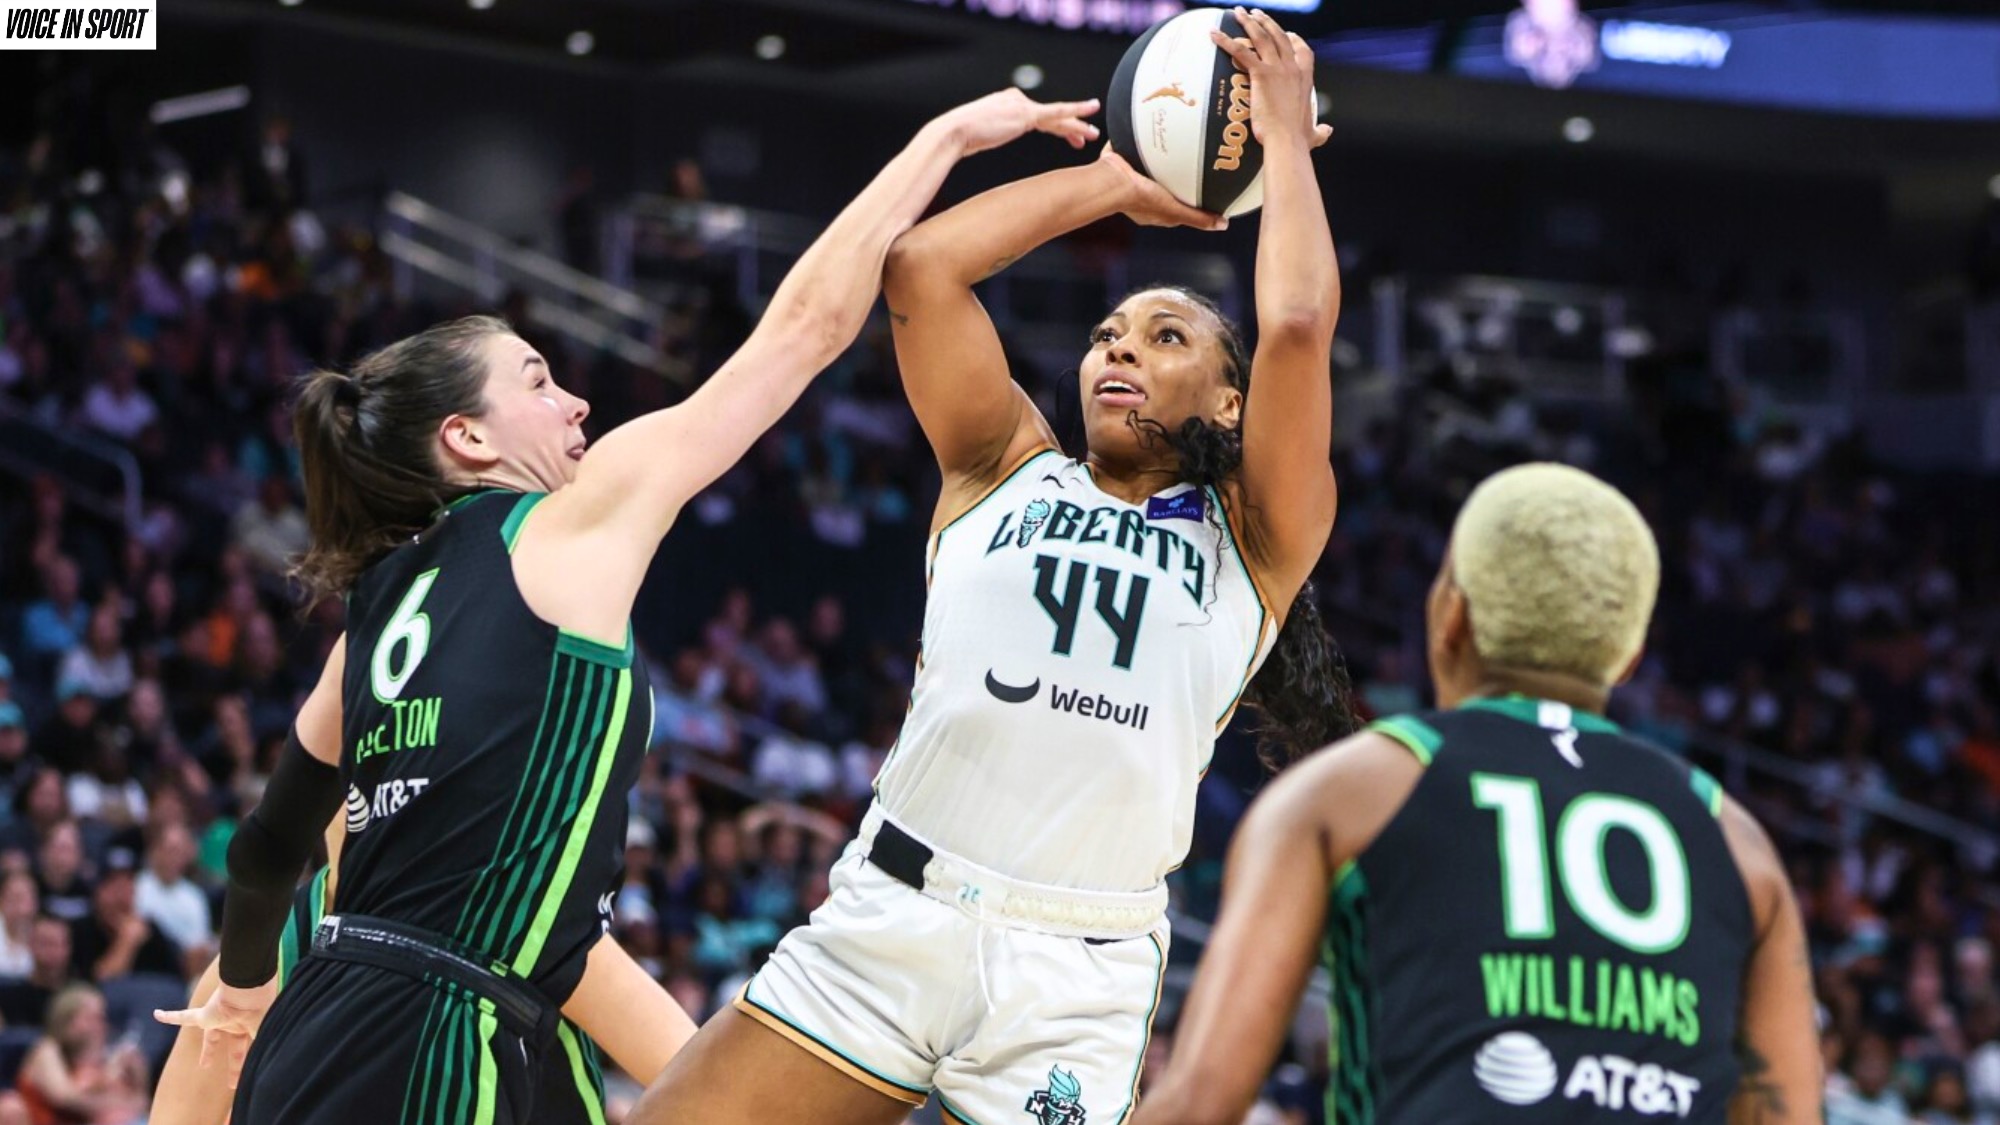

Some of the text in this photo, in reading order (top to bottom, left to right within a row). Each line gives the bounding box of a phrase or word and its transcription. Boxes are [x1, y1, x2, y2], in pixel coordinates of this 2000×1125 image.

[1153, 506, 1199, 517] BARCLAYS
[370, 566, 441, 704] 6
[1031, 553, 1151, 671] 44
[1050, 684, 1149, 731] Webull
[1470, 771, 1691, 955] 10
[1481, 953, 1700, 1047] WILLIAMS
[1564, 1055, 1701, 1117] AT&T
